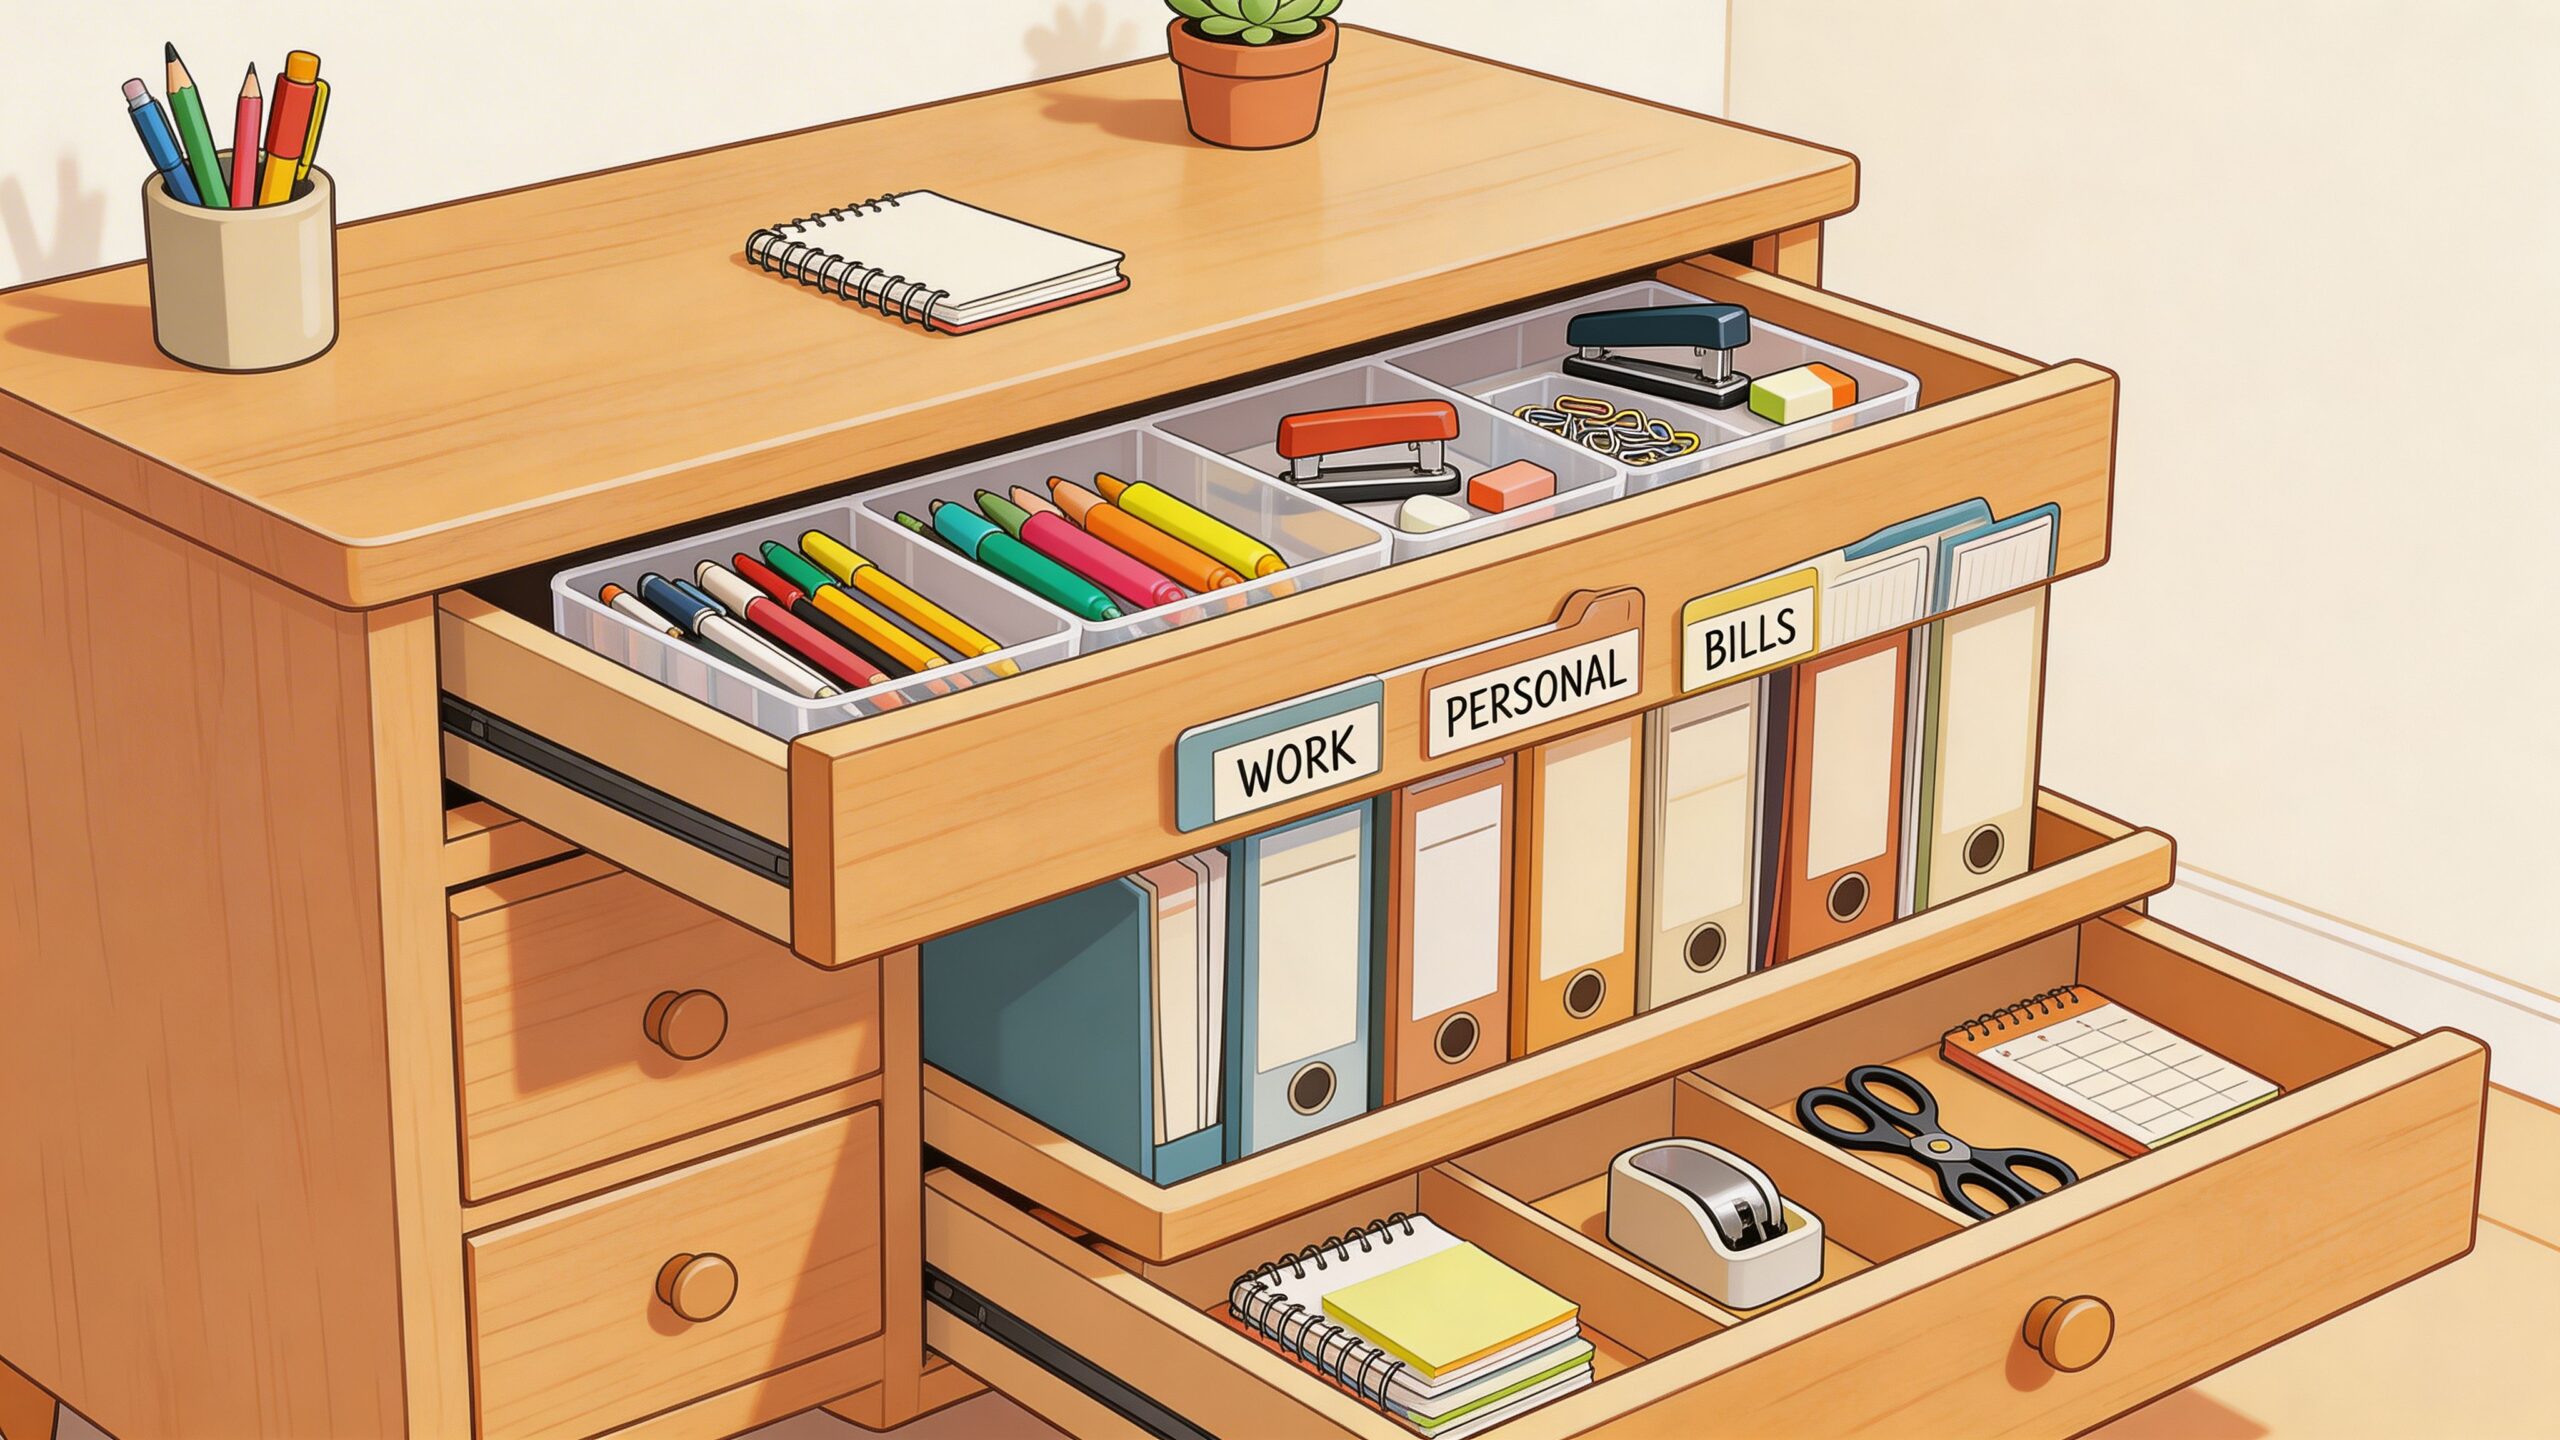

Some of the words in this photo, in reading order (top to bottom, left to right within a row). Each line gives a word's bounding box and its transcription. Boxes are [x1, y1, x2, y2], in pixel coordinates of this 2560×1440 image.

[1705, 607, 1796, 671] BILLS
[1446, 648, 1627, 738] PERSONAL
[1236, 724, 1357, 798] WORK
